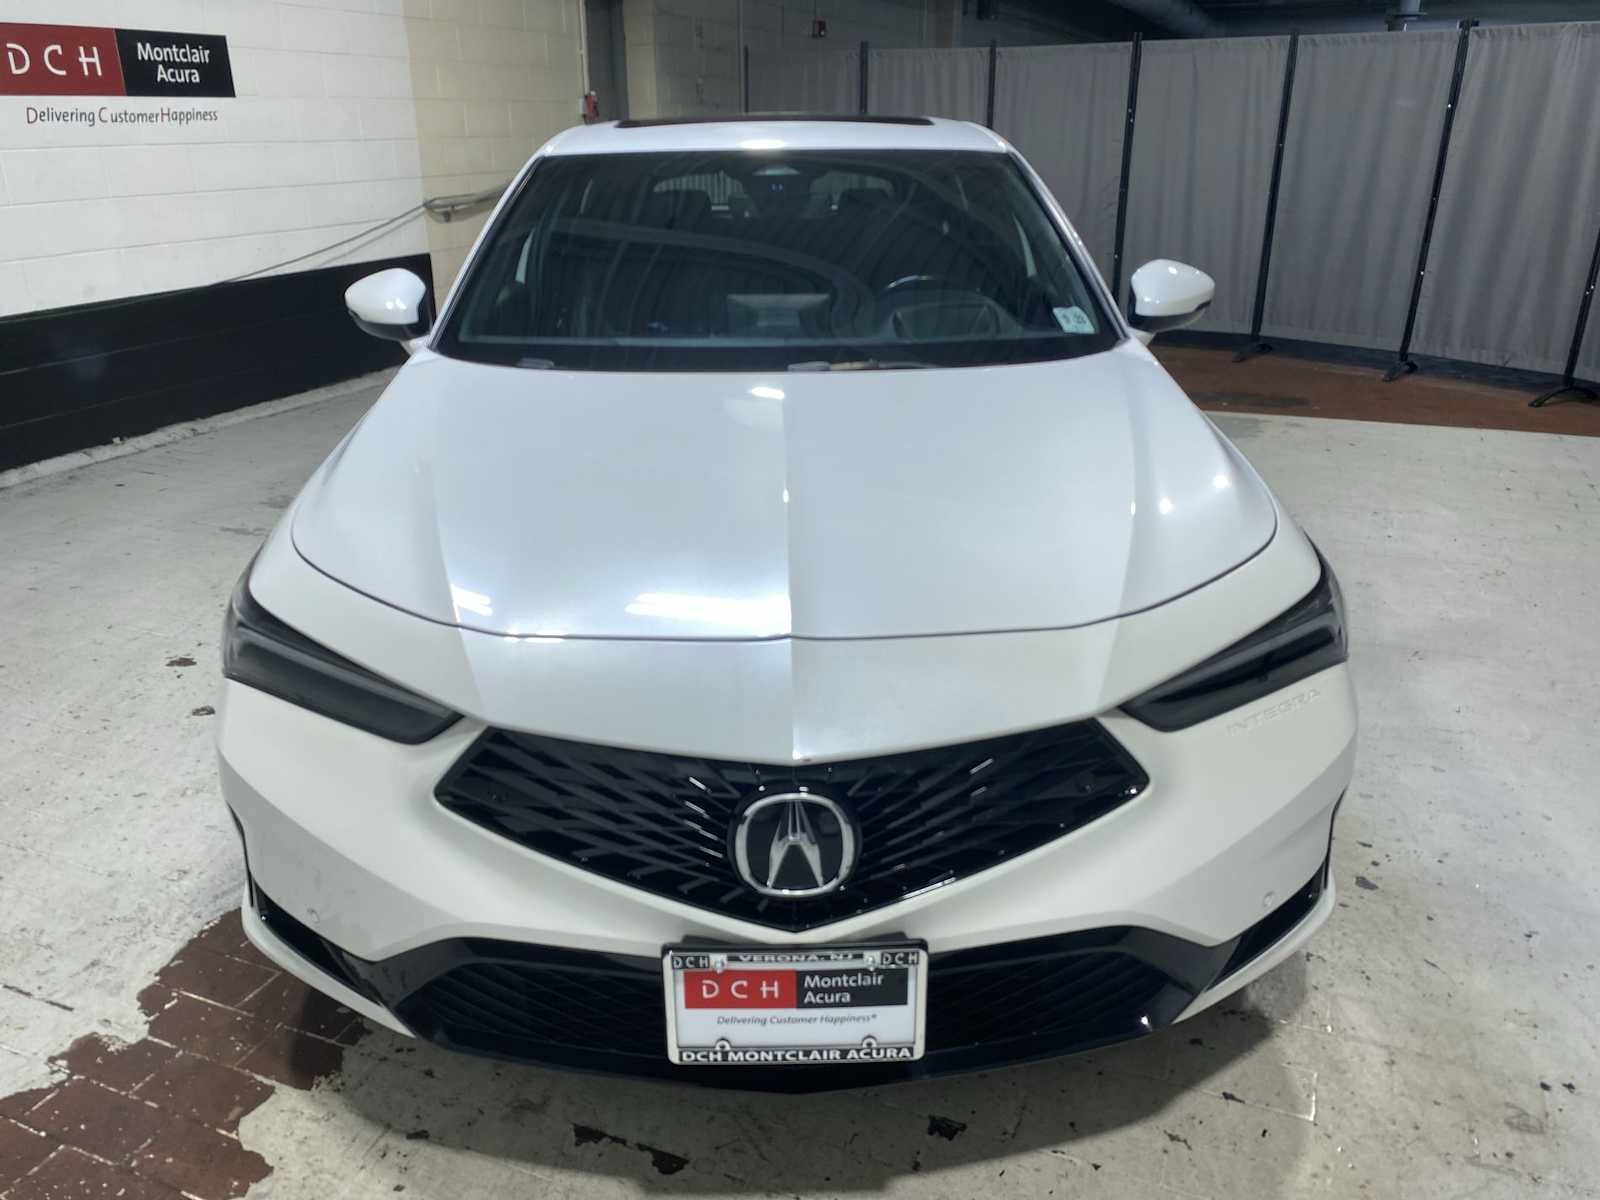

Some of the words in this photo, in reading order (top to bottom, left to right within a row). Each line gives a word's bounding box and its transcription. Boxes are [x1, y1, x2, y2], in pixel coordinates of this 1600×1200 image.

[137, 42, 210, 64] Montclair
[157, 64, 200, 83] Acura
[26, 106, 96, 127] Delivering
[804, 973, 884, 988] Montclair
[804, 991, 851, 1004] Acura
[717, 1016, 767, 1026] Delivering
[769, 1015, 817, 1024] Customer
[682, 1051, 722, 1062] DCH
[728, 1050, 841, 1062] MONTCLAIR
[847, 1048, 911, 1060] ACURA
